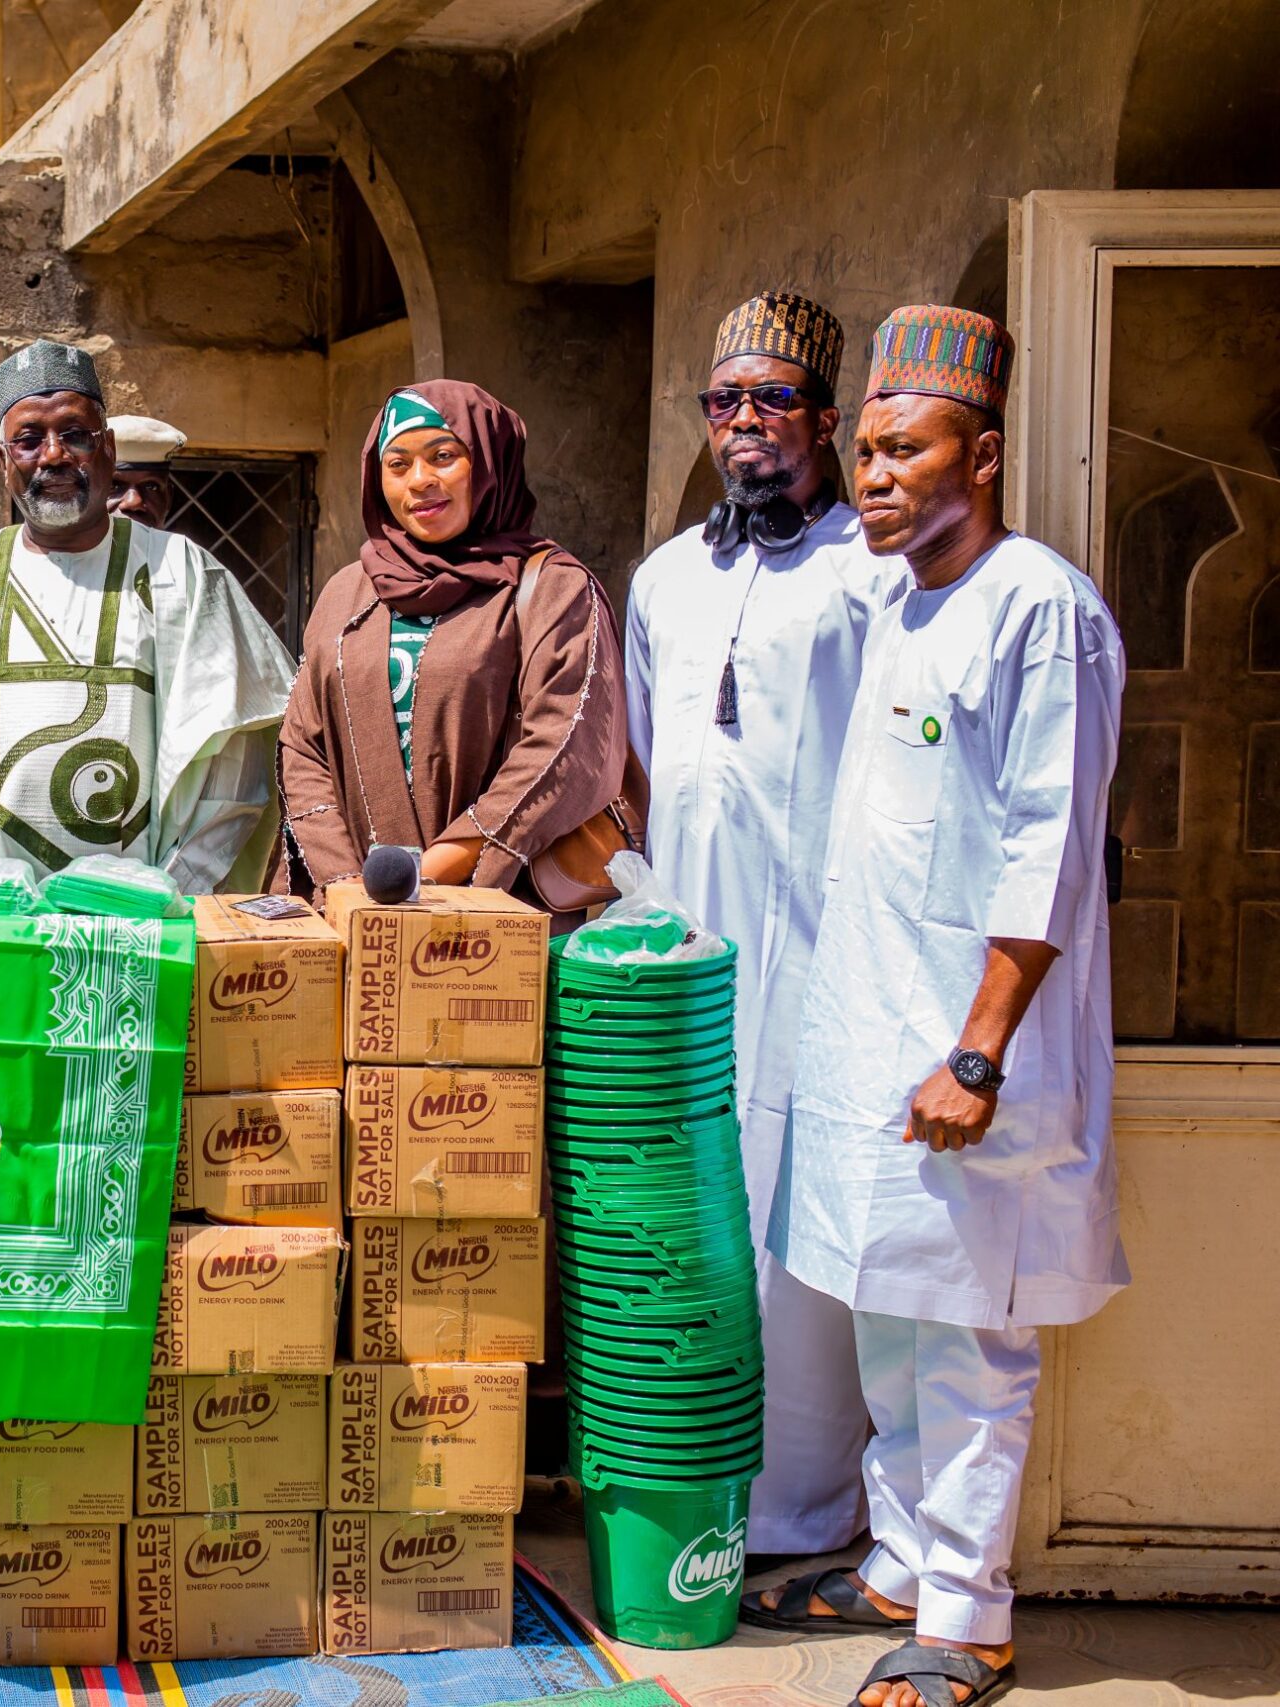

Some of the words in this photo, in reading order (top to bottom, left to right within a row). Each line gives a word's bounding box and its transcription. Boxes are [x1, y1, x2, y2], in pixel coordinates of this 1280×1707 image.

[384, 917, 398, 964] SALE
[496, 920, 540, 931] 200x20g
[291, 948, 336, 959] 200x20g
[423, 938, 491, 964] MILO
[220, 969, 289, 996] MILO
[359, 916, 384, 1052] SAMPLES
[383, 970, 395, 1008] FOR
[382, 1017, 394, 1052] NOT
[381, 1071, 394, 1118] SALE
[492, 1073, 536, 1083] 200x20g
[420, 1092, 488, 1117] MILO
[214, 1124, 283, 1151] MILO
[358, 1071, 381, 1206] SAMPLES
[380, 1125, 393, 1162] FOR
[176, 1159, 189, 1196] FOR
[380, 1171, 392, 1206] NOT
[494, 1225, 538, 1235] 200x20g
[171, 1232, 184, 1279] SALE
[209, 1253, 278, 1278] MILO
[385, 1225, 398, 1271] SALE
[423, 1244, 490, 1270] MILO
[171, 1285, 183, 1323] FOR
[363, 1225, 385, 1358] SAMPLES
[385, 1277, 397, 1314] FOR
[171, 1332, 183, 1367] NOT
[385, 1323, 397, 1358] NOT
[364, 1372, 377, 1418] SALE
[475, 1376, 519, 1386] 200x20g
[166, 1376, 179, 1422] SALE
[204, 1392, 271, 1419] MILO
[402, 1393, 470, 1418] MILO
[167, 1428, 180, 1464] FOR
[341, 1371, 364, 1503] SAMPLES
[363, 1424, 375, 1461] FOR
[169, 1473, 181, 1507] NOT
[363, 1470, 375, 1504] NOT
[66, 1530, 110, 1540] 200x20g
[265, 1518, 309, 1529] 200x20g
[460, 1514, 503, 1524] 200x20g
[158, 1523, 171, 1568] SALE
[195, 1539, 262, 1565] MILO
[353, 1519, 366, 1563] SALE
[391, 1534, 457, 1560] MILO
[684, 1539, 744, 1583] MILO
[138, 1523, 160, 1654] SAMPLES
[159, 1574, 172, 1610] FOR
[333, 1519, 354, 1647] SAMPLES
[354, 1569, 366, 1604] FOR
[161, 1620, 173, 1654] NOT
[355, 1613, 367, 1647] NOT
